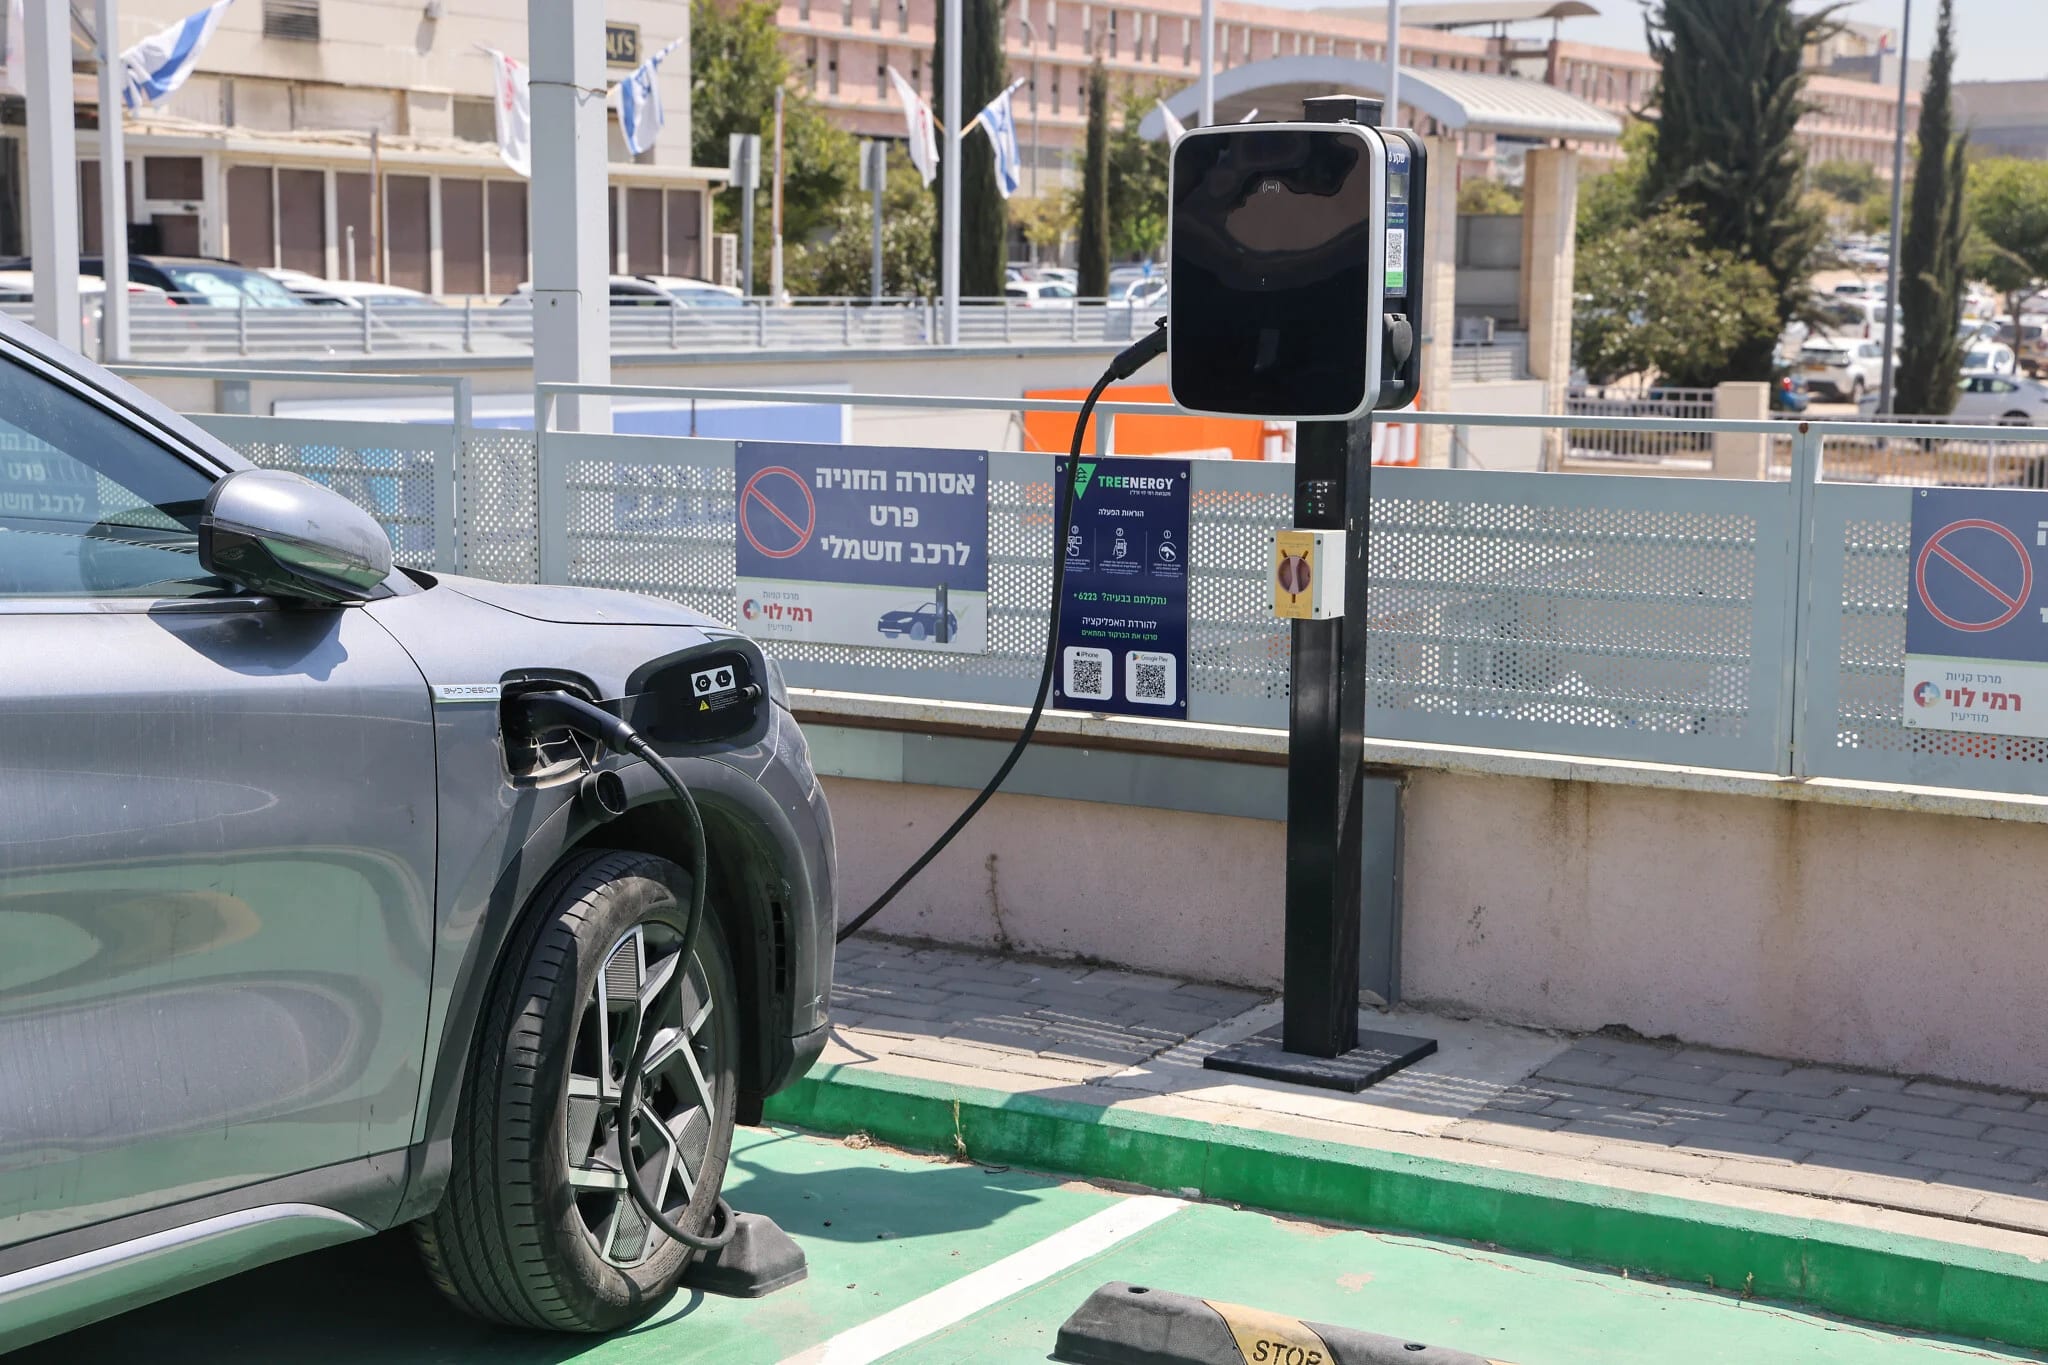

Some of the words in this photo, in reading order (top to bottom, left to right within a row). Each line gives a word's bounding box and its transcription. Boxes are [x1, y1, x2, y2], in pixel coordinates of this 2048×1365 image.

[8, 462, 46, 480] פרט
[816, 467, 887, 491] החניה
[896, 471, 975, 495] אסורה
[1098, 475, 1174, 490] TREENERGY
[40, 493, 85, 513] לרכב
[870, 504, 918, 528] פרט
[1098, 508, 1120, 516] הפעלה
[1121, 509, 1144, 517] הוראות
[820, 535, 902, 563] חשמלי
[910, 541, 970, 566] לרכב
[1102, 592, 1131, 603] בבעיה?
[1133, 595, 1167, 606] נתקלתם
[763, 603, 783, 620] לוי
[787, 606, 812, 622] רמי
[1082, 616, 1125, 627] האפליקציה
[1128, 619, 1157, 629] להורדת
[1082, 629, 1106, 637] המתאים
[1108, 631, 1130, 639] הברקוד
[1080, 651, 1099, 659] iPhone
[1946, 671, 1974, 683] קניות
[1977, 673, 2002, 684] מרכז
[465, 686, 498, 694] DESIGN
[1945, 686, 1976, 708] לוי
[1982, 690, 2022, 712] רמי
[1950, 711, 1989, 723] מודיעין
